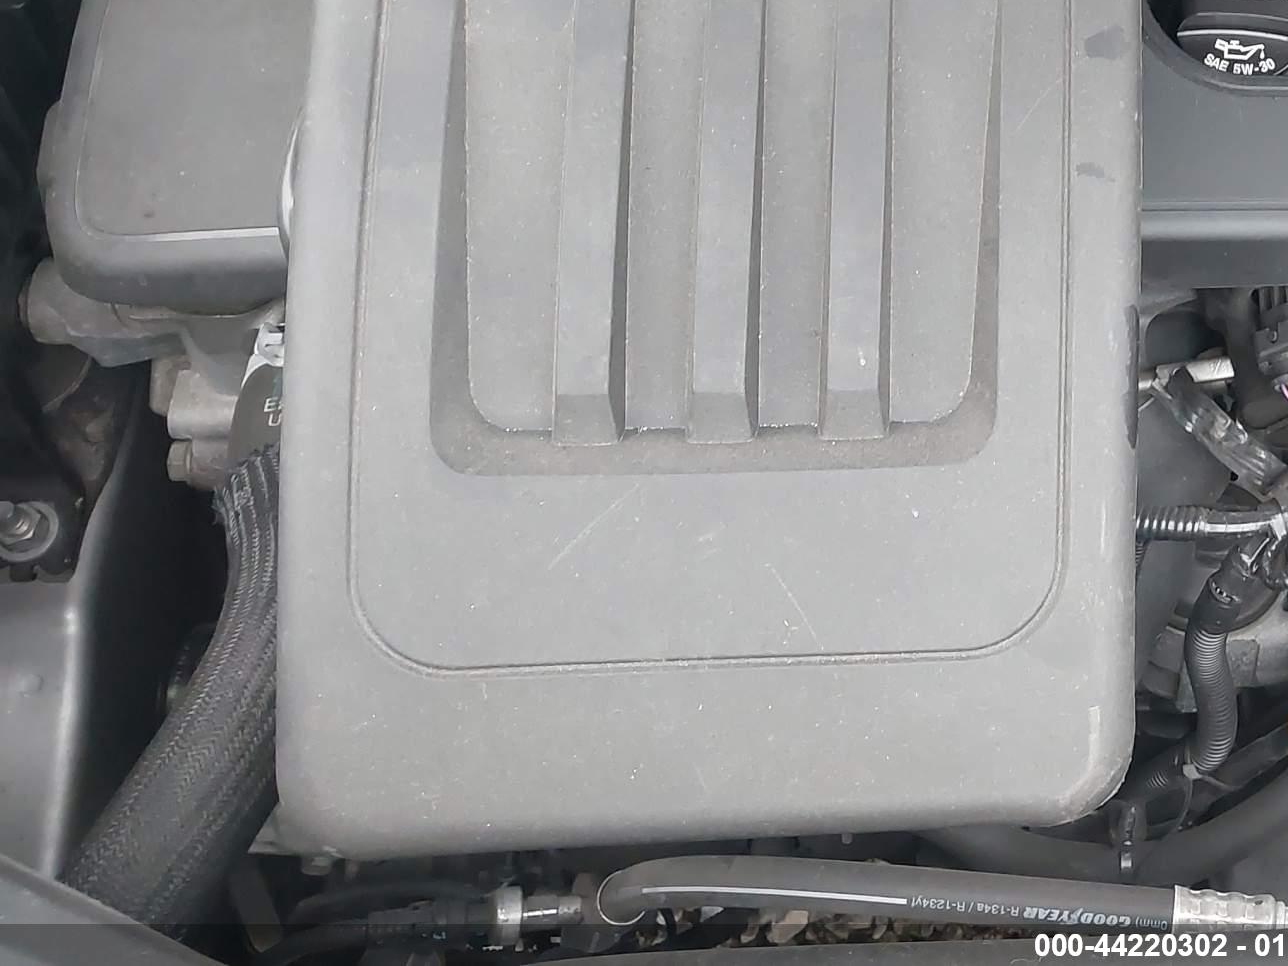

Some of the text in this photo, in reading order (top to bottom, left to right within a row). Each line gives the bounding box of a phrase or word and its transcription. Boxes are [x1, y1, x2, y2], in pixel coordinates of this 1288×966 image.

[1204, 53, 1276, 76] SAE 5W-30
[263, 396, 282, 413] E
[911, 894, 966, 912] R-1234yf
[977, 902, 1020, 917] R-134a
[1023, 906, 1131, 927] GOODYEAR
